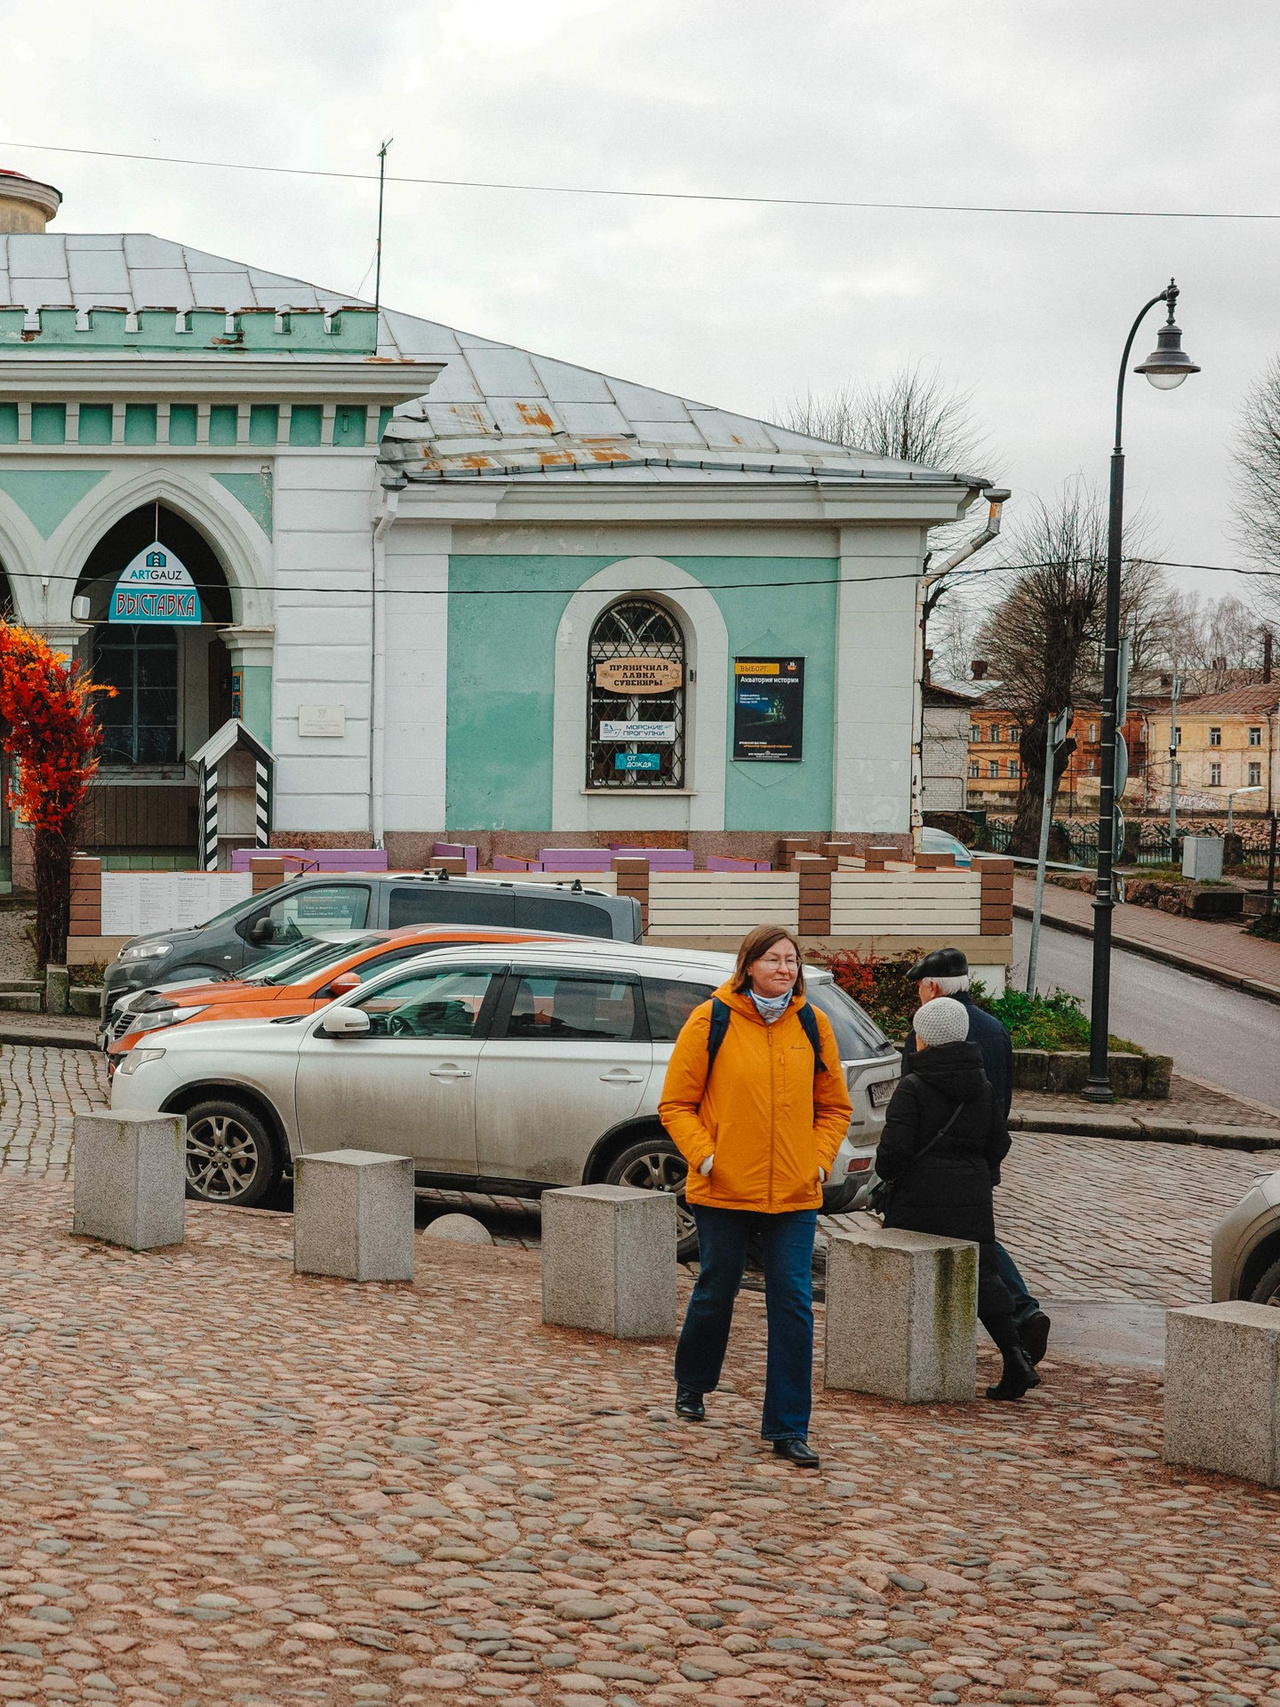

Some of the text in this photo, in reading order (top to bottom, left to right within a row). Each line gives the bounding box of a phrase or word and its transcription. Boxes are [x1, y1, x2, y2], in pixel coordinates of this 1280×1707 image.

[129, 569, 182, 580] ARTGAUZ
[116, 592, 195, 617] ВЫСТАВКА
[740, 676, 799, 685] Акватория истории
